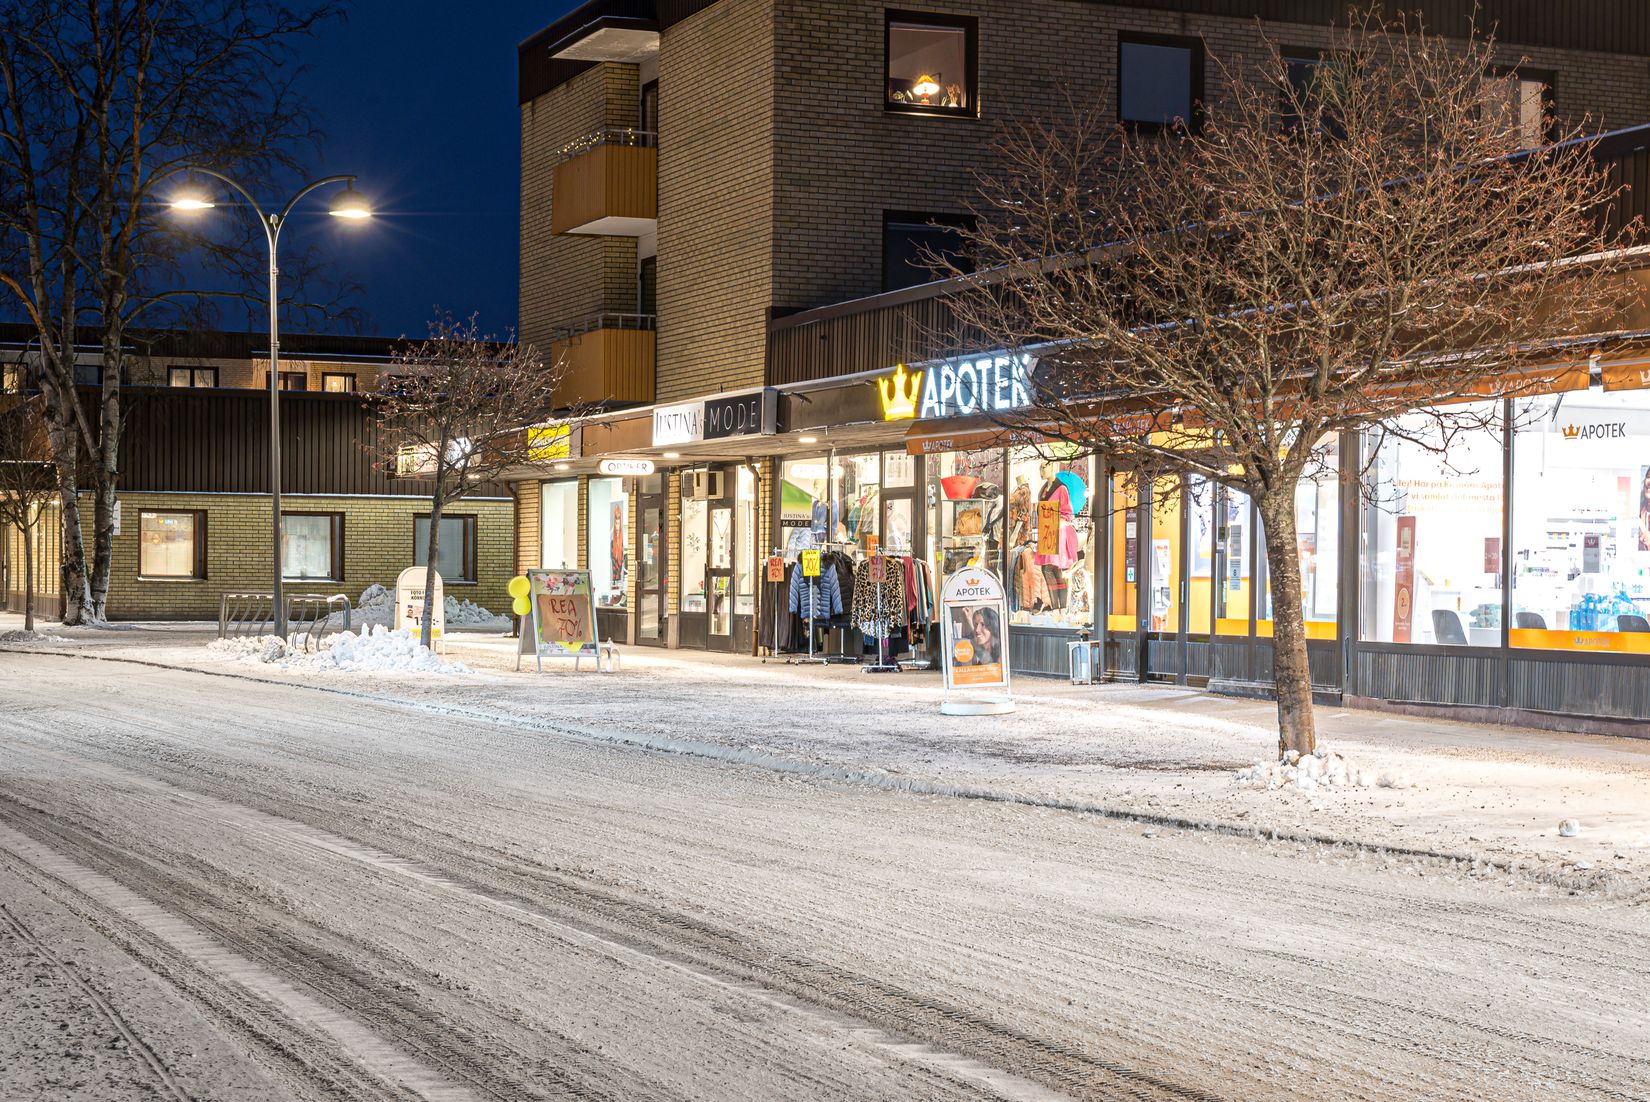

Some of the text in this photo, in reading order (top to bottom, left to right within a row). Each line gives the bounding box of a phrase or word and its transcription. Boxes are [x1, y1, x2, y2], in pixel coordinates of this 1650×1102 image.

[920, 353, 1031, 419] APOTEK
[1507, 375, 1556, 396] APOTEK
[709, 401, 757, 433] MODE
[1580, 422, 1626, 440] APOTEK
[930, 439, 954, 452] APOTEK
[607, 462, 648, 473] OPTIKER
[955, 587, 991, 597] APOTEK
[550, 598, 577, 617] REA
[557, 617, 582, 638] 70%
